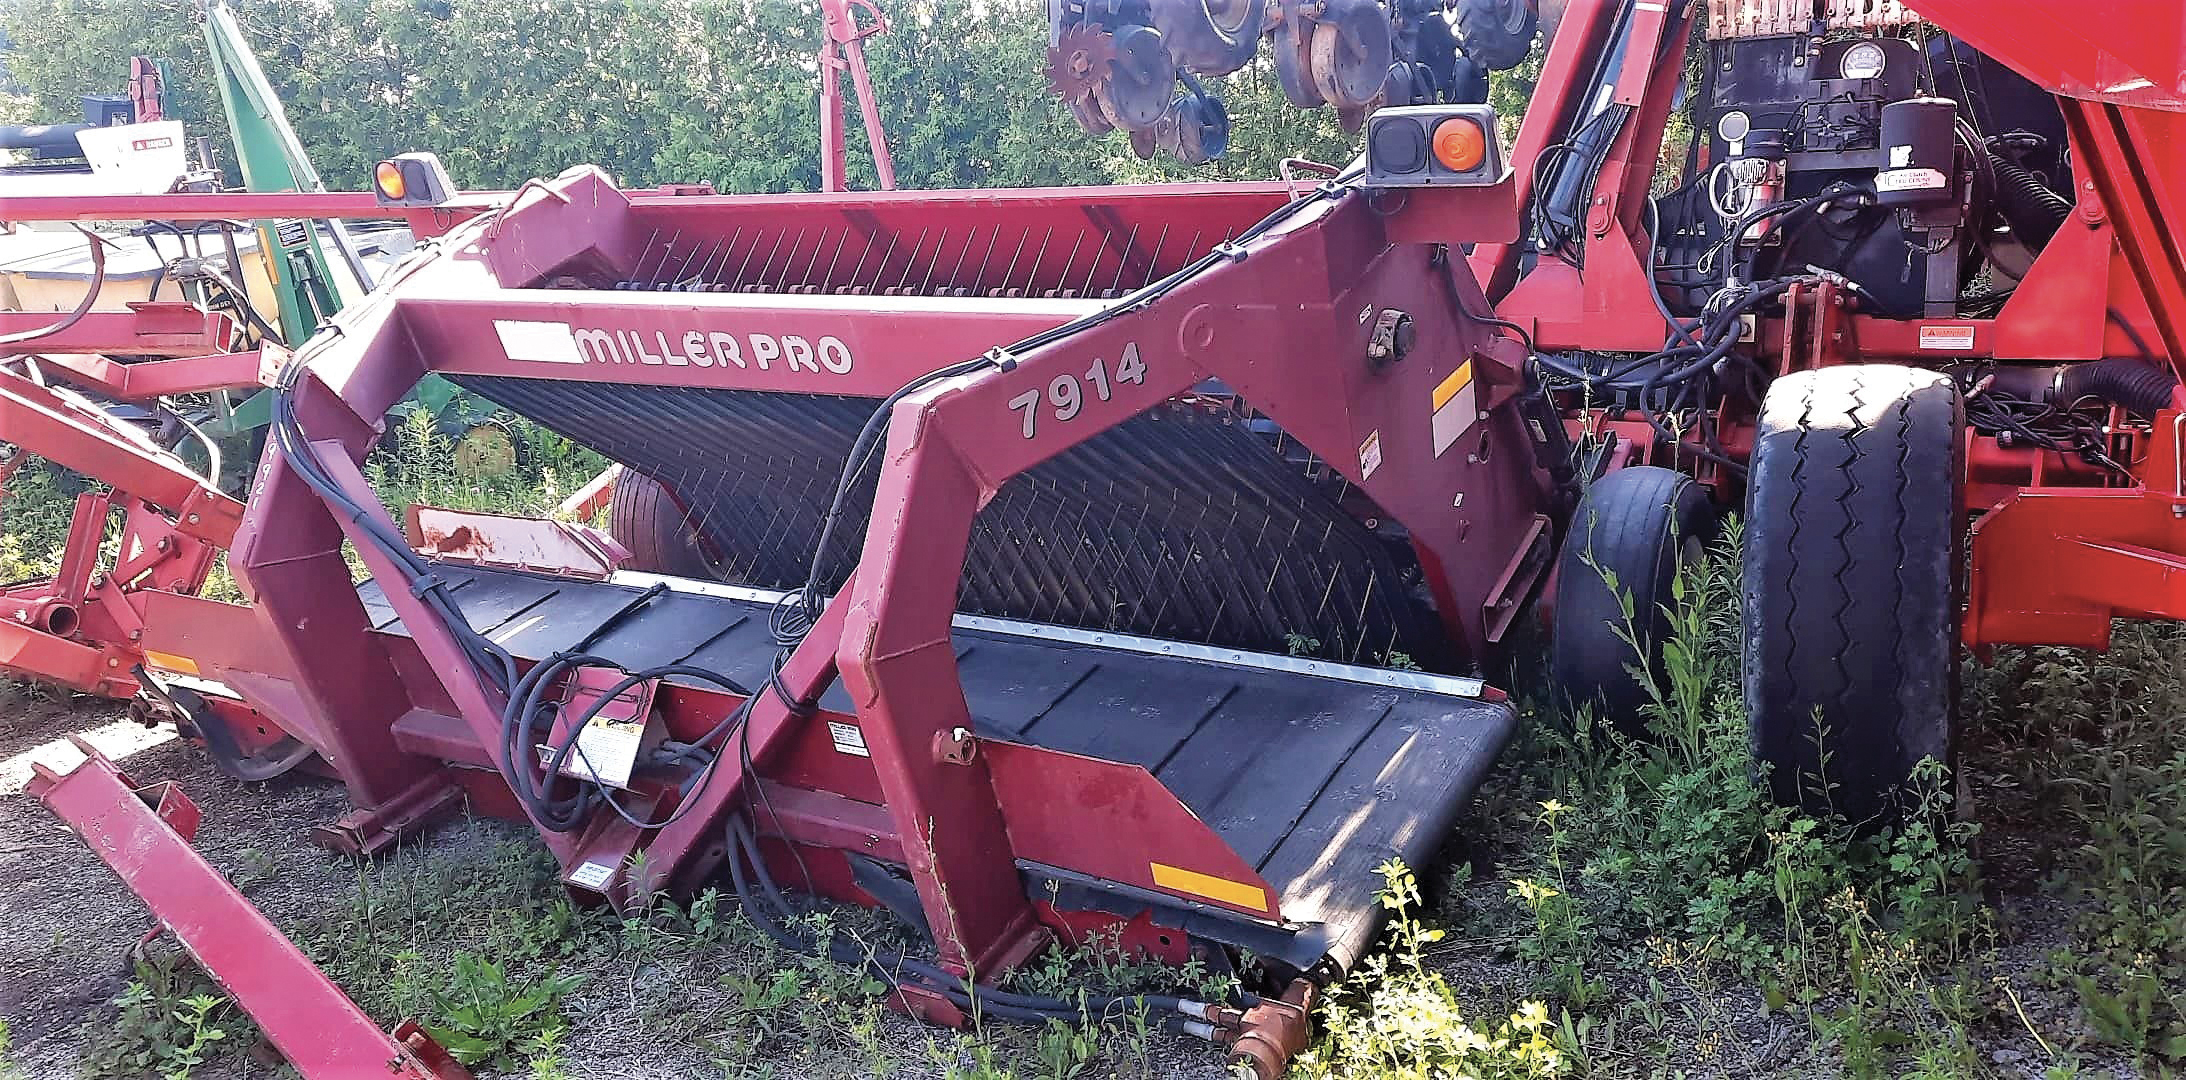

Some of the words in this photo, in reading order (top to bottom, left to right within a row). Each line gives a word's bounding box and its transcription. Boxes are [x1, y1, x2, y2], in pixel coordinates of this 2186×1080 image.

[574, 328, 747, 370] MILLER
[749, 334, 853, 375] PRO
[1008, 342, 1147, 440] 7914
